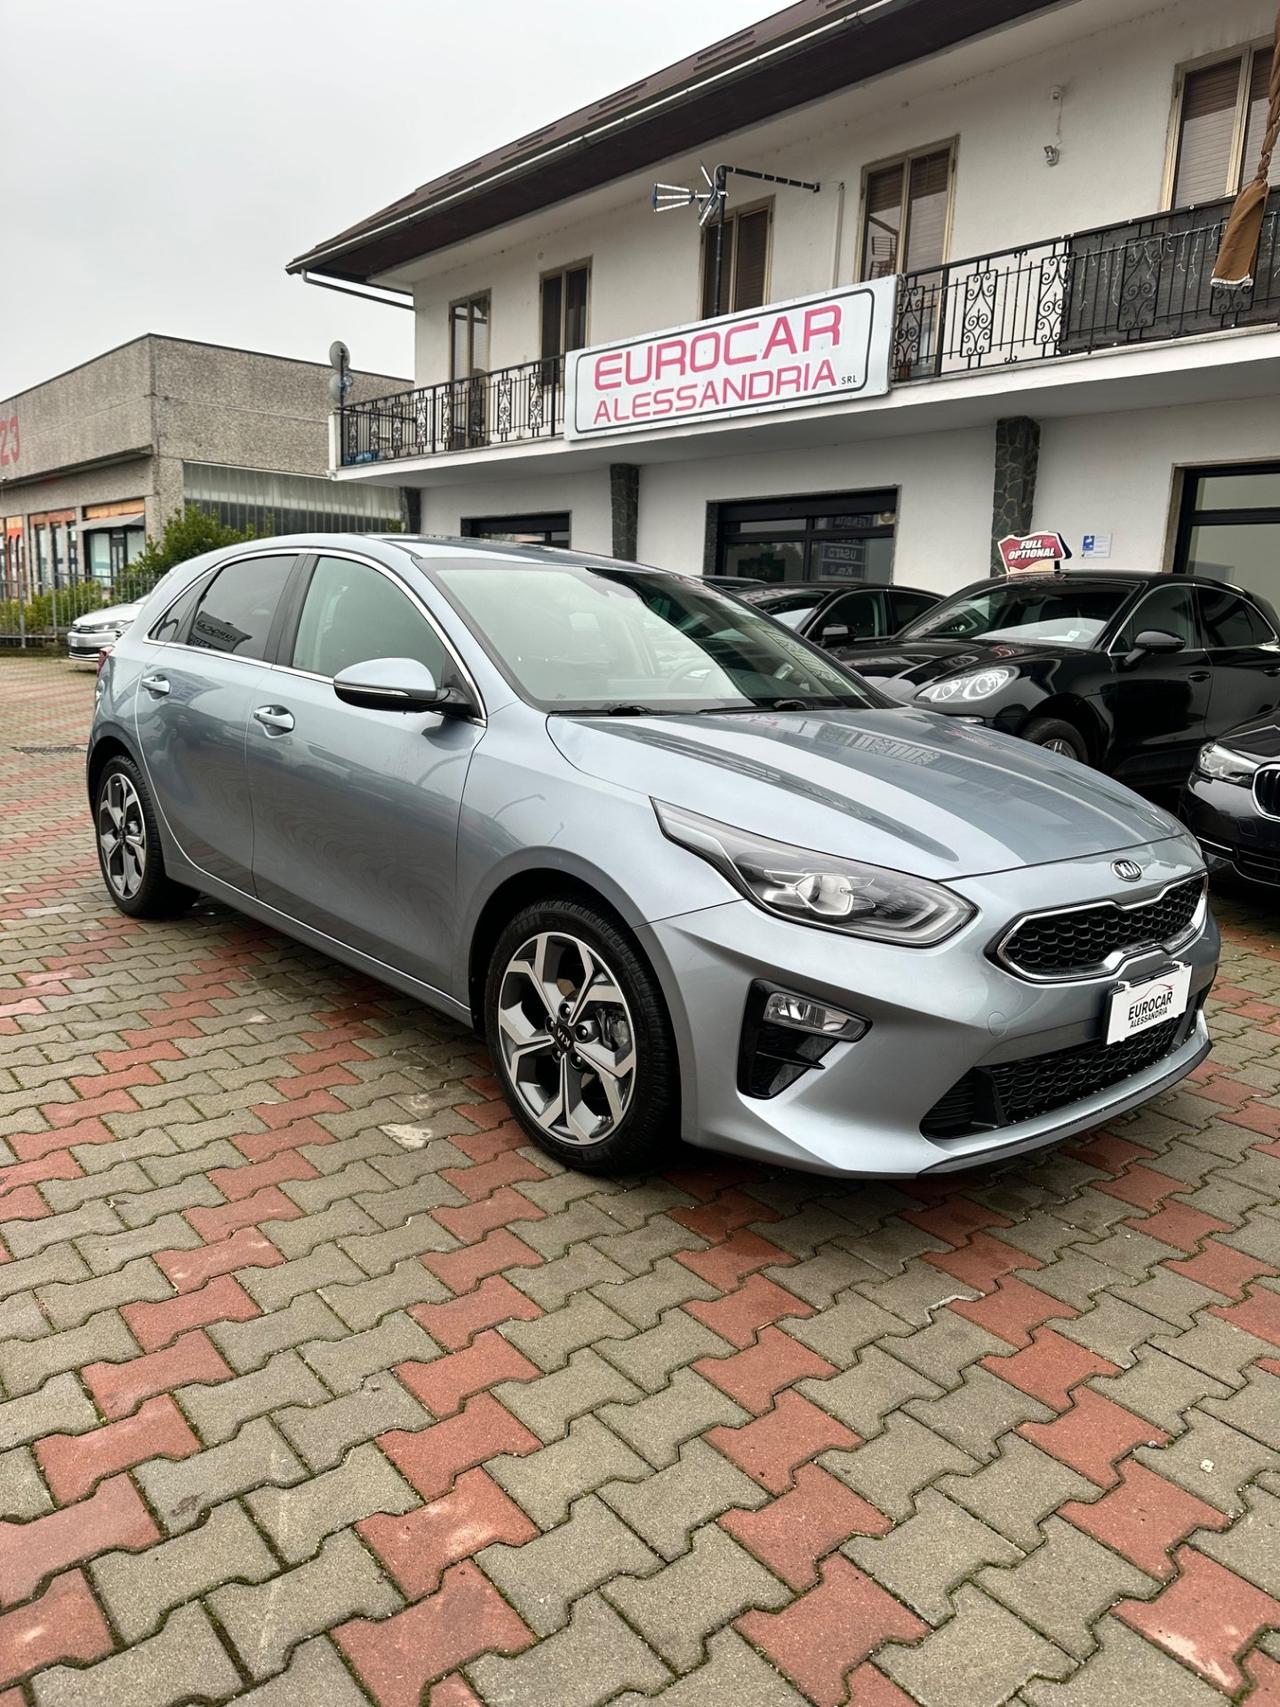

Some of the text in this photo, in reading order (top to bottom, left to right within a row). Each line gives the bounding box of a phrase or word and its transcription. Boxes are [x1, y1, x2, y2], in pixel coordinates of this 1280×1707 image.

[594, 304, 842, 391] EUROCAR
[593, 359, 857, 425] ALESSANDRIA SRL
[1008, 547, 1055, 560] OPTIONAL
[1020, 539, 1043, 550] FULL
[1116, 861, 1142, 878] KIA
[1127, 991, 1173, 1021] EUROCAR
[1129, 1006, 1168, 1029] ALESSANDRIA
